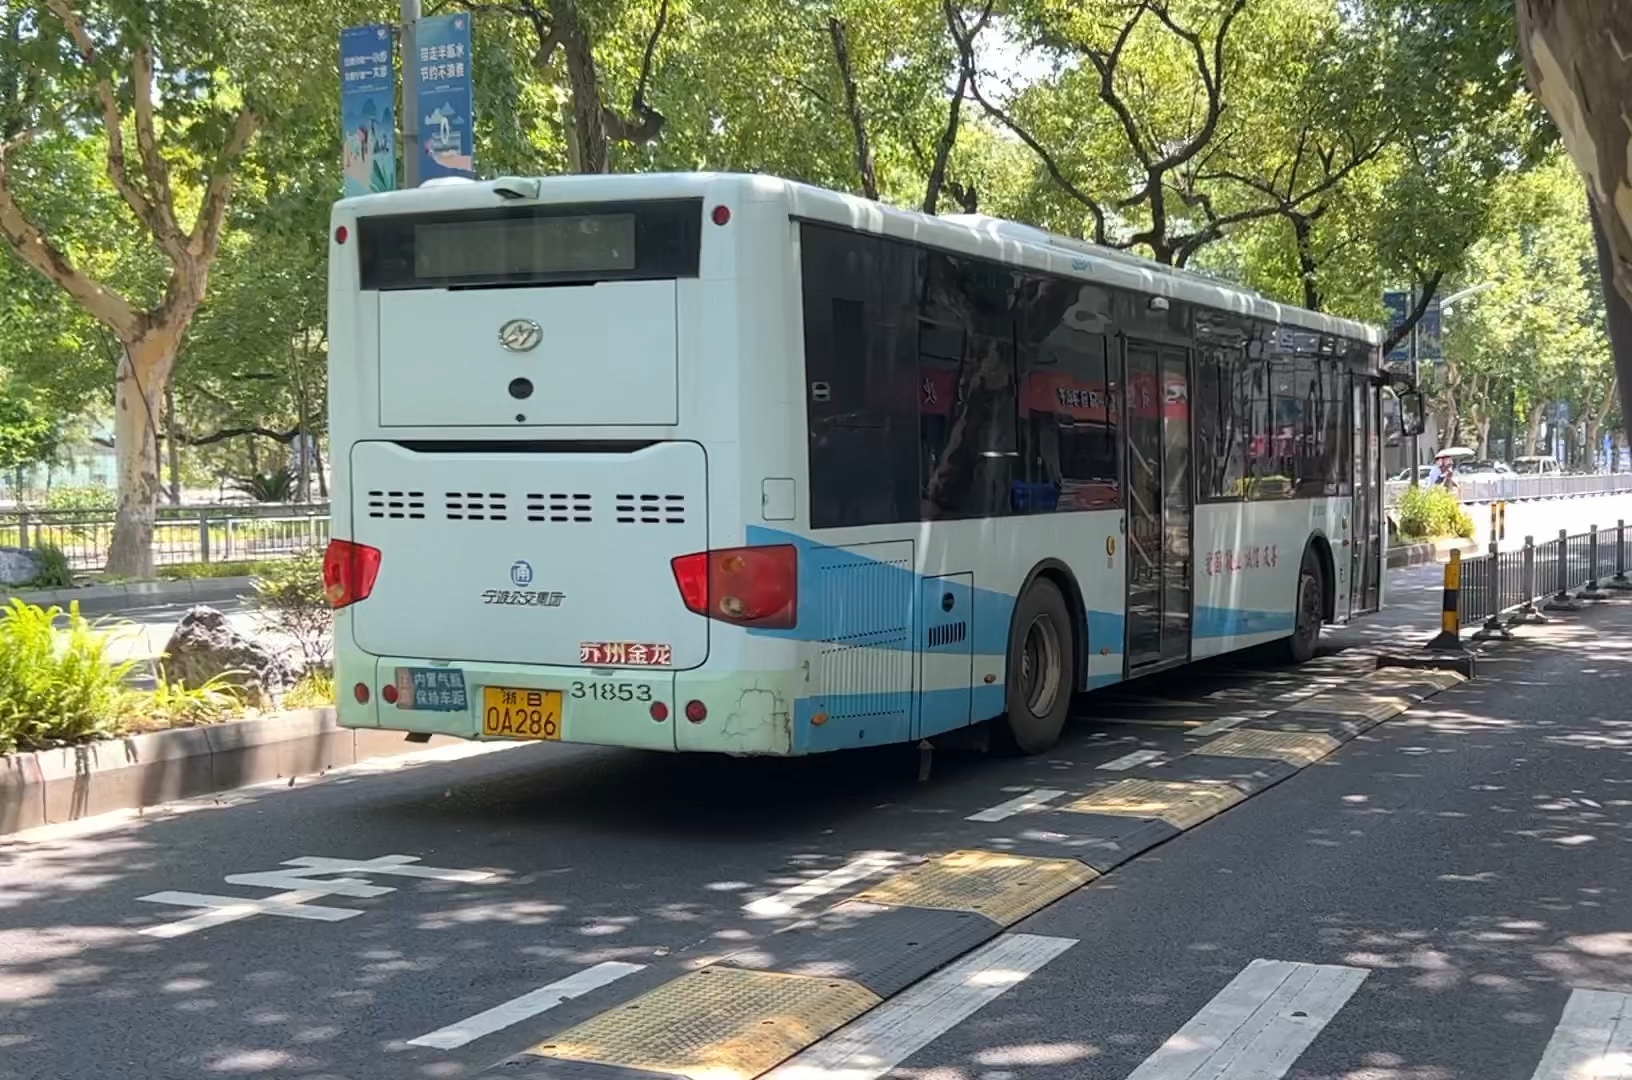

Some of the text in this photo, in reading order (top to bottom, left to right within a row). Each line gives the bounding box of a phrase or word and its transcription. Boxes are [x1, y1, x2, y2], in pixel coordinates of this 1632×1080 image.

[580, 642, 671, 665] 苏州金龙
[416, 690, 465, 705] 保持车距
[571, 681, 652, 701] 31853
